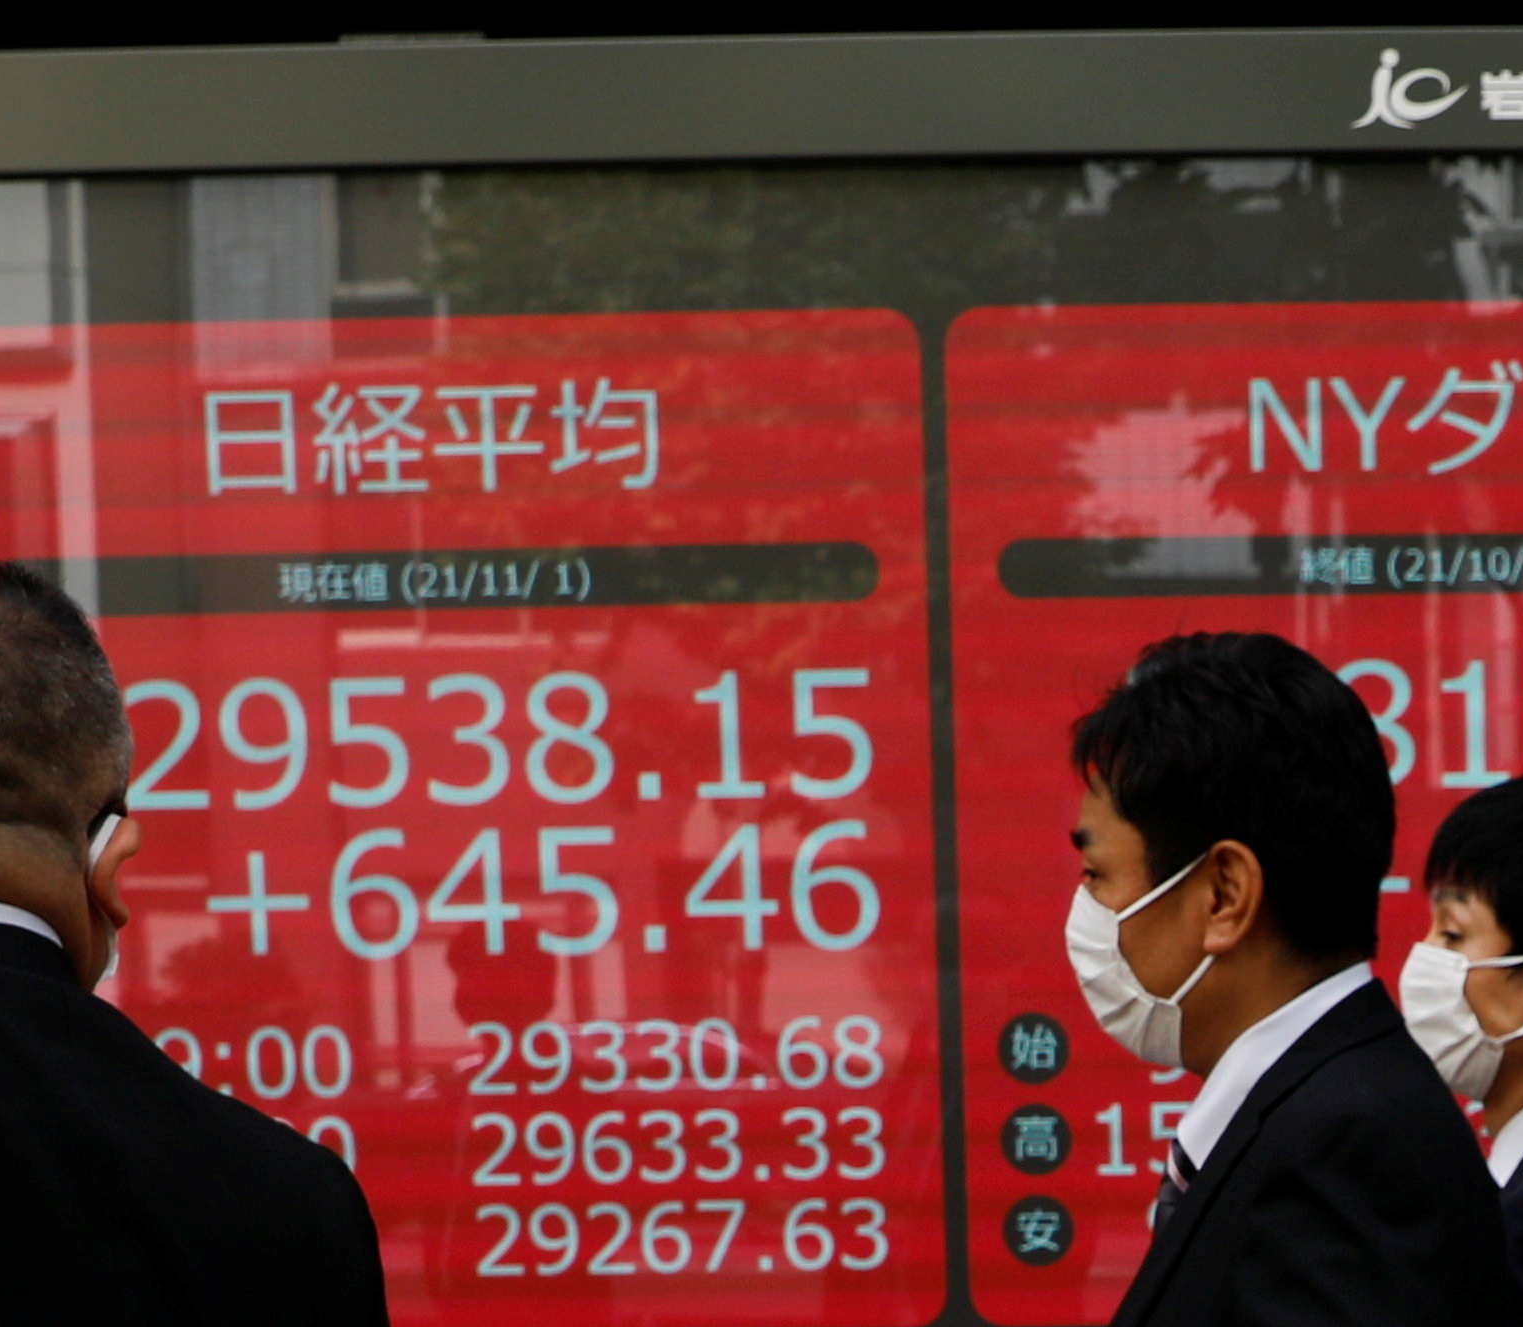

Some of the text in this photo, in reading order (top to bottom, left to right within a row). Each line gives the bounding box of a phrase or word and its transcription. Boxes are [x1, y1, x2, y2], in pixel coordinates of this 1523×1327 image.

[207, 381, 656, 491] 日経平均
[282, 563, 391, 602] 現在値
[124, 670, 871, 808] 29538.15
[209, 821, 878, 958] +645.46
[471, 1018, 881, 1092] 29330.68
[1012, 1026, 1057, 1069] 始
[476, 1109, 882, 1184] 29633.33
[1015, 1116, 1058, 1161] 高
[481, 1200, 886, 1274] 29267.63
[1018, 1209, 1059, 1252] 安
